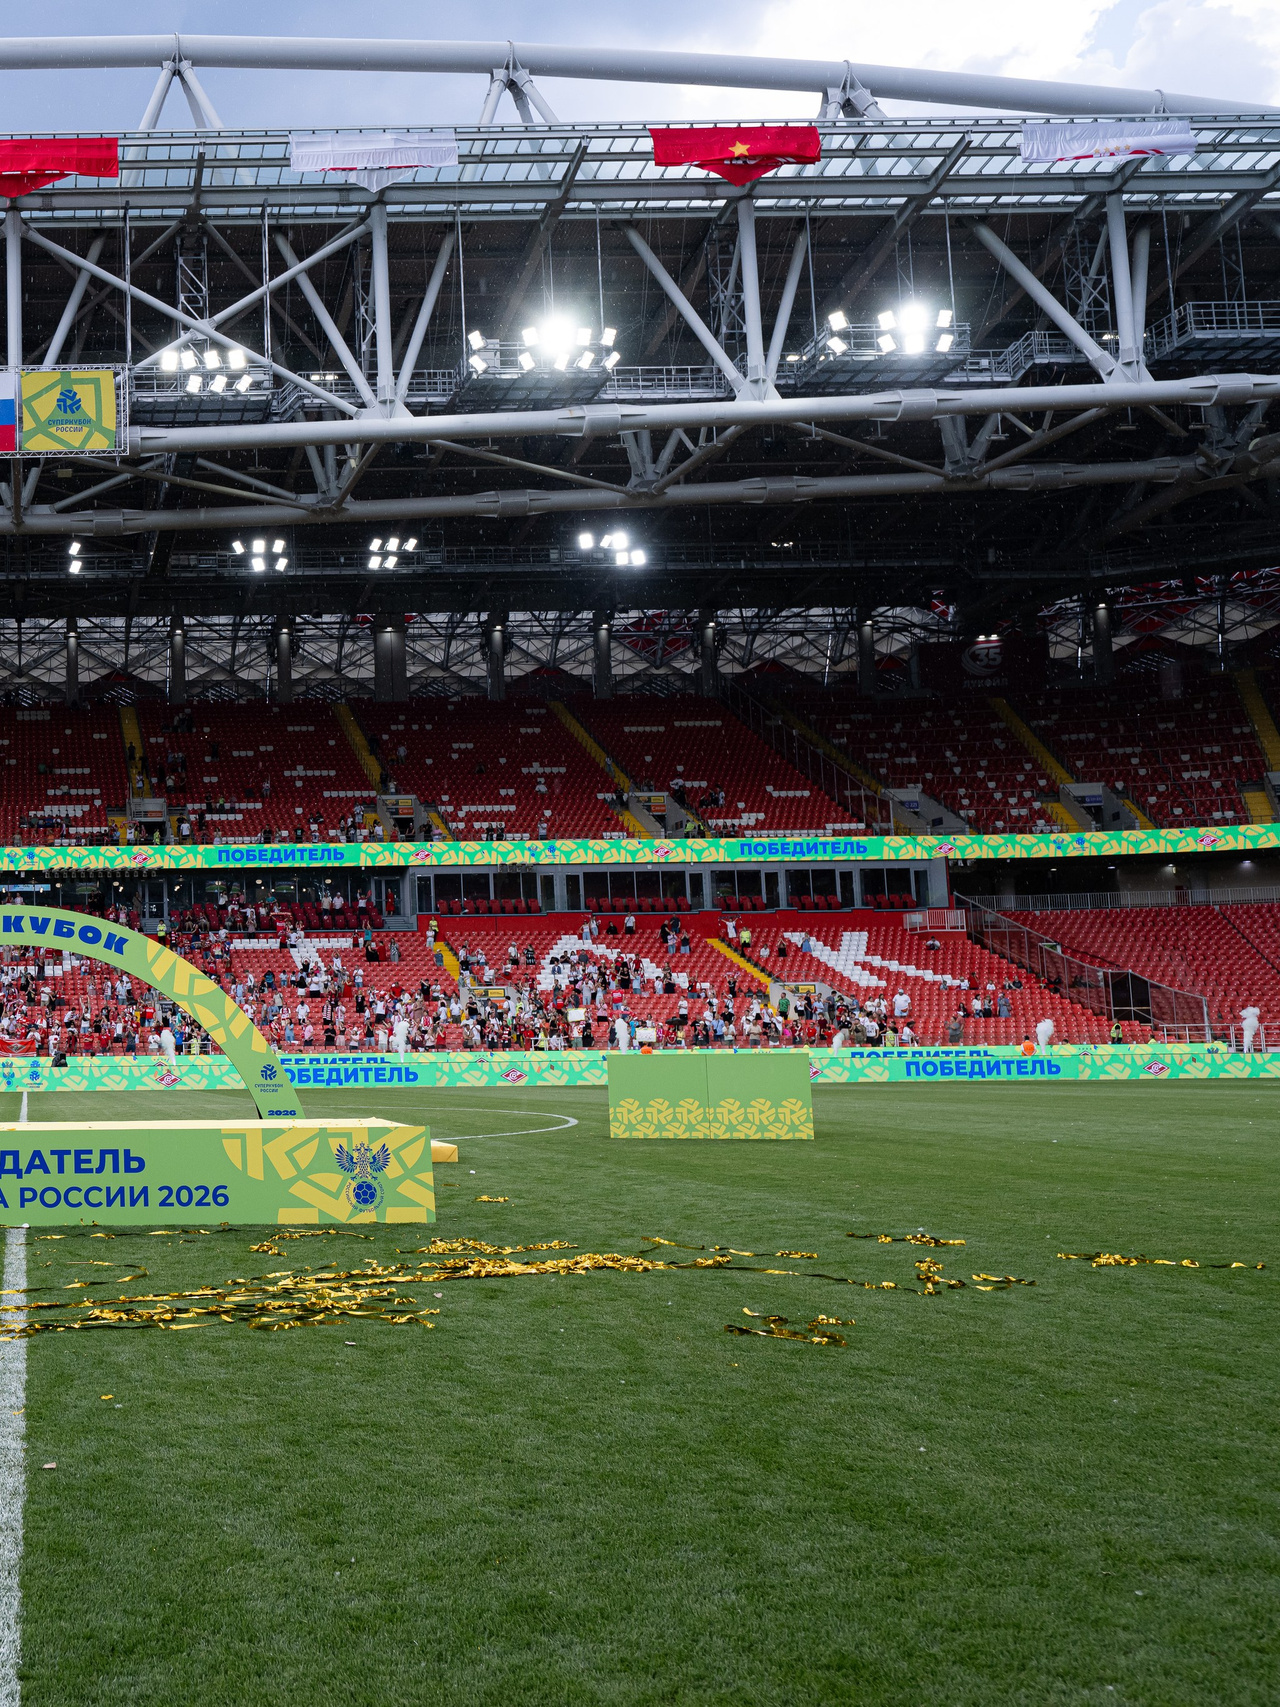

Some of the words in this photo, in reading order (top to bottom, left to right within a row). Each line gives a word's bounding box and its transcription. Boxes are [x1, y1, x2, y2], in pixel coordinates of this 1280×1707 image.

[975, 647, 1002, 667] 35
[218, 848, 345, 864] ПОБЕДИТЕЛЬ
[740, 841, 868, 857] ПОБЕДИТЕЛЬ
[283, 1067, 419, 1086] ОБЕДИТЕЛЬ
[905, 1059, 1061, 1078] ПОБЕДИТЕЛЬ
[19, 1185, 150, 1208] РОССИИ
[157, 1184, 230, 1207] 2026
